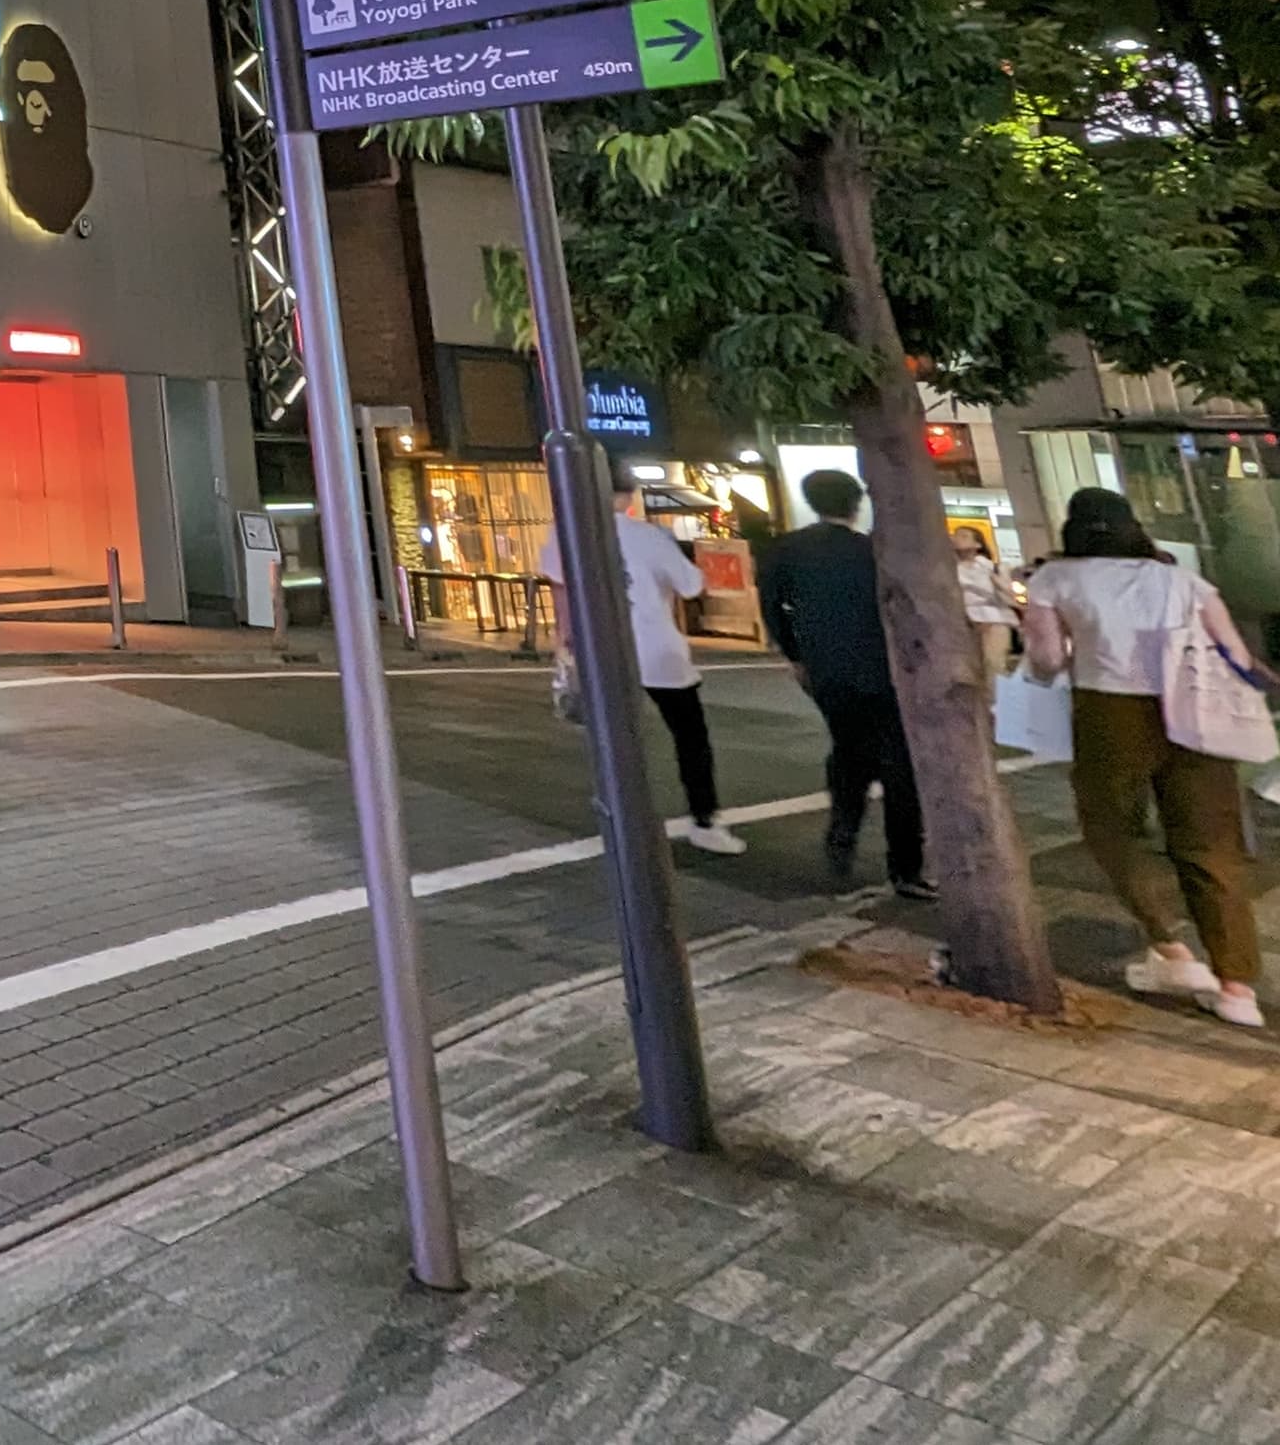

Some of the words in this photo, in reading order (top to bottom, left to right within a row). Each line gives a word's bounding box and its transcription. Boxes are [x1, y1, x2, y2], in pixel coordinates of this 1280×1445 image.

[317, 44, 530, 94] NHK放送センター
[583, 59, 634, 79] 450m
[320, 94, 362, 114] NHK
[365, 76, 487, 109] Broadcasting
[491, 66, 560, 91] Center
[587, 382, 647, 416] olumbia
